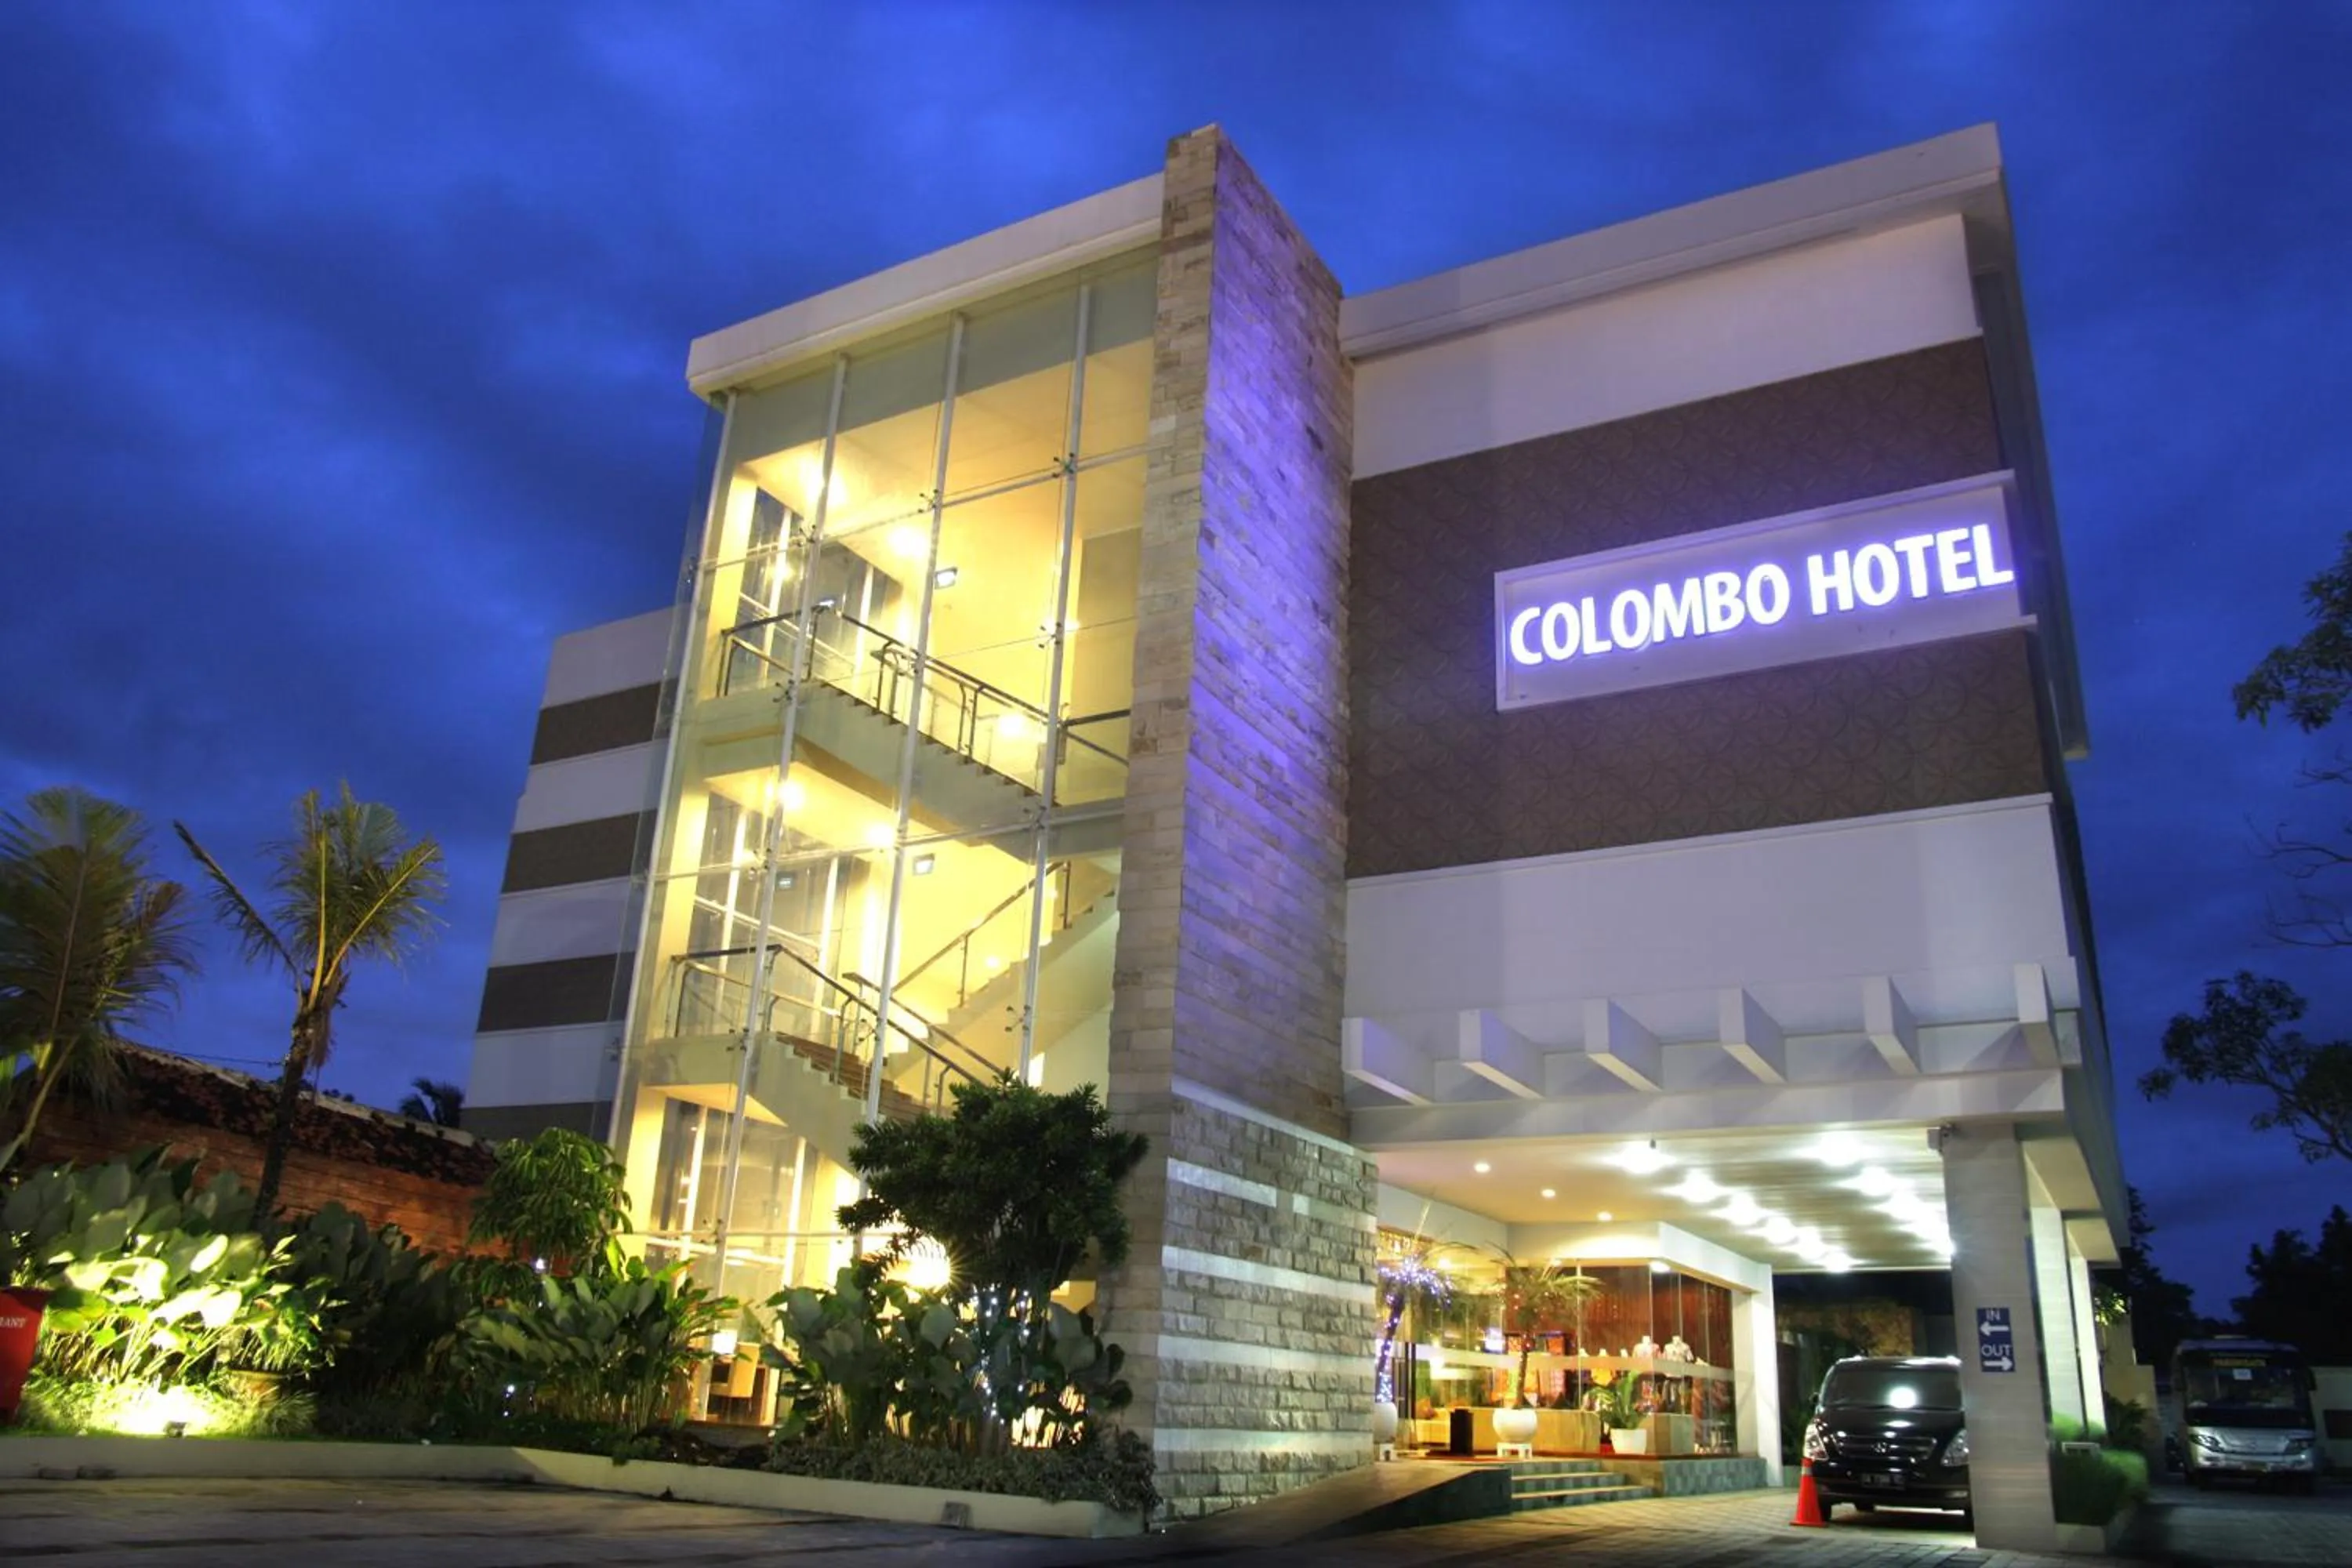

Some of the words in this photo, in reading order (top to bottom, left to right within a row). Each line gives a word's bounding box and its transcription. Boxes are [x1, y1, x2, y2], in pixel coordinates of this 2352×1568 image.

[1509, 563, 1791, 666] COLOMBO
[1806, 523, 2015, 615] HOTEL
[1986, 1309, 2001, 1320] IN
[1980, 1344, 2011, 1357] OUT
